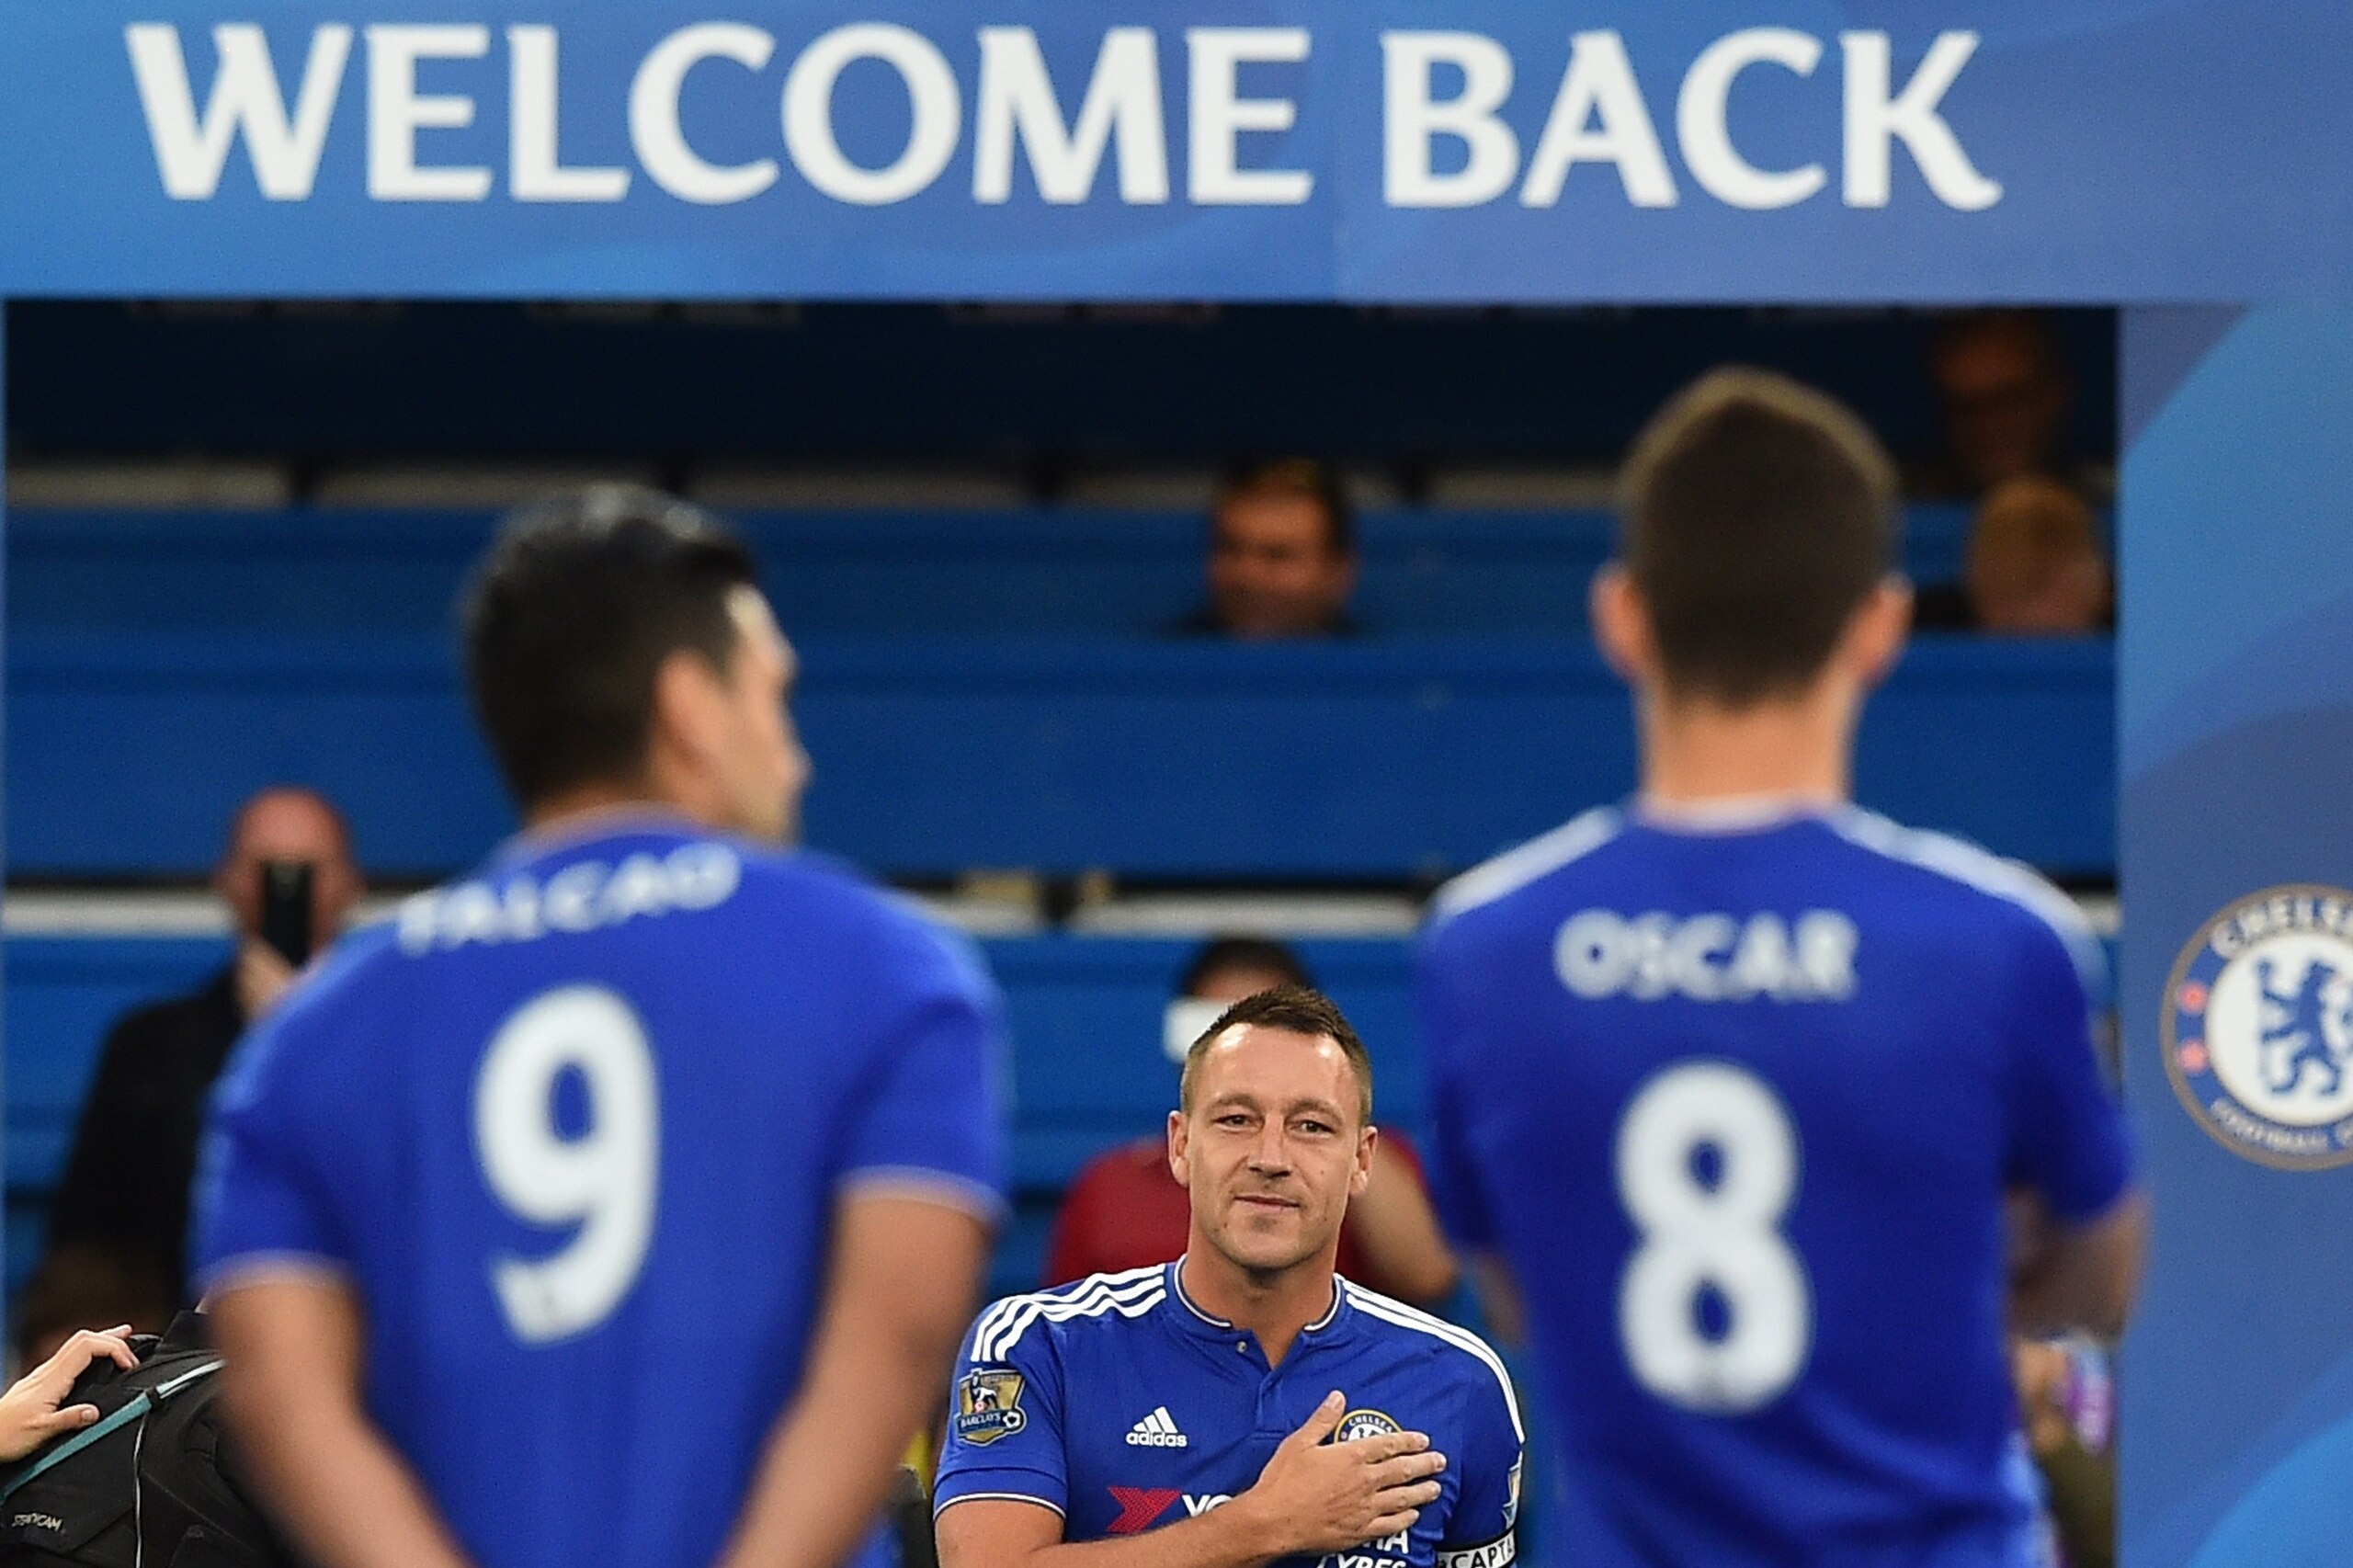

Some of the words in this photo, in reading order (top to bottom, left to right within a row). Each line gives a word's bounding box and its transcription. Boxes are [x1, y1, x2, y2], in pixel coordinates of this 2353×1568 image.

[124, 21, 1313, 206] WELCOME
[1381, 26, 2005, 210] BACK
[397, 844, 741, 958] FALCAO
[1553, 908, 1860, 1002] OSCAR
[472, 983, 662, 1344] 9
[1614, 1061, 1813, 1415] 8
[960, 1411, 1002, 1428] BARCLAYS
[1125, 1430, 1188, 1448] adidas
